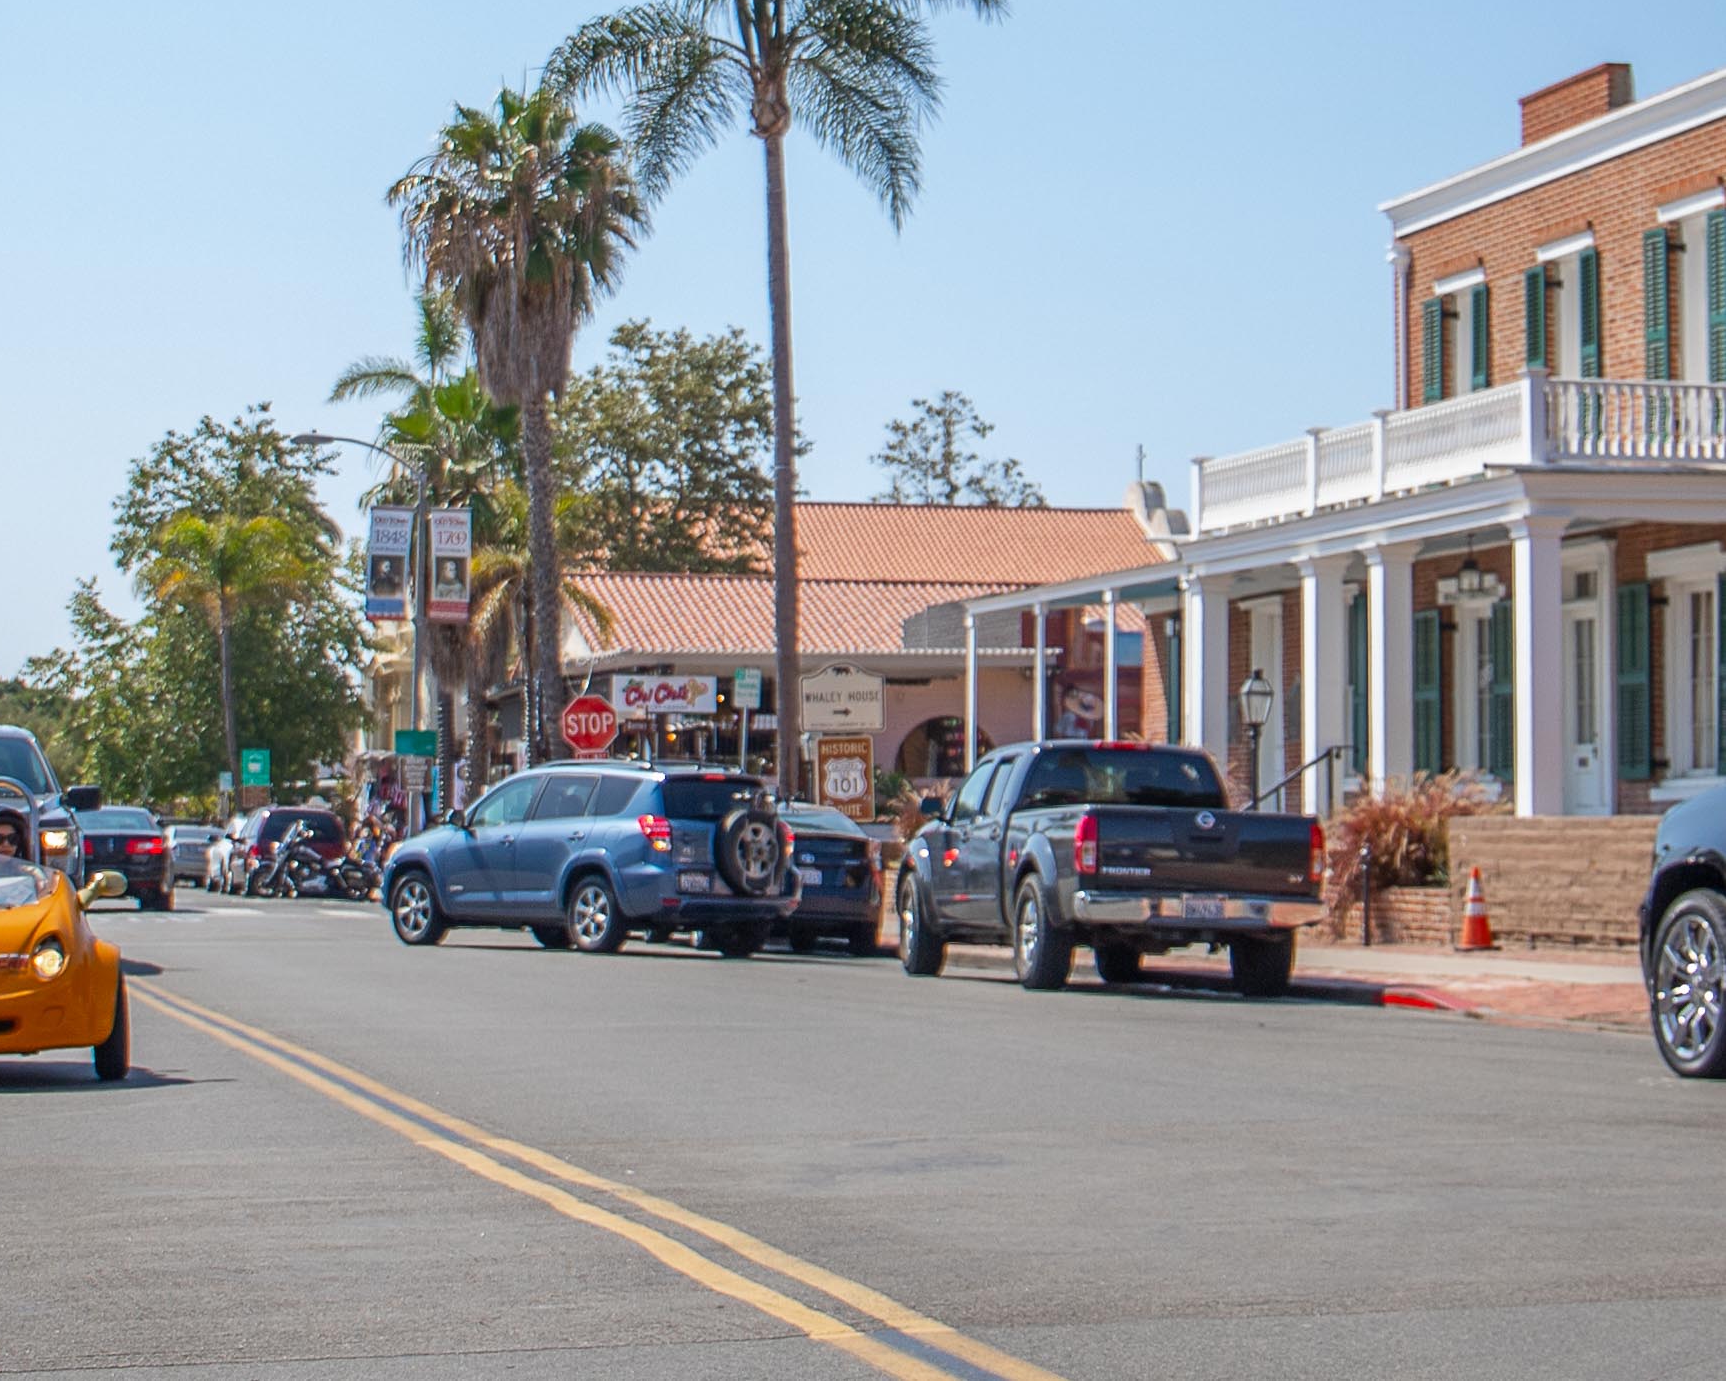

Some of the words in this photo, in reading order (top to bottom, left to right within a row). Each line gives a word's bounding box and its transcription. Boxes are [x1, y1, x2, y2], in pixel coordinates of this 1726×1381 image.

[375, 529, 407, 545] 1848
[437, 530, 468, 546] 1769
[805, 691, 842, 703] WHALEY
[848, 690, 880, 703] HOUSE
[567, 711, 613, 736] STOP
[821, 741, 868, 756] HISTORIC
[833, 778, 859, 794] 101
[838, 803, 863, 816] OUTE
[1102, 866, 1151, 876] FRONTIER
